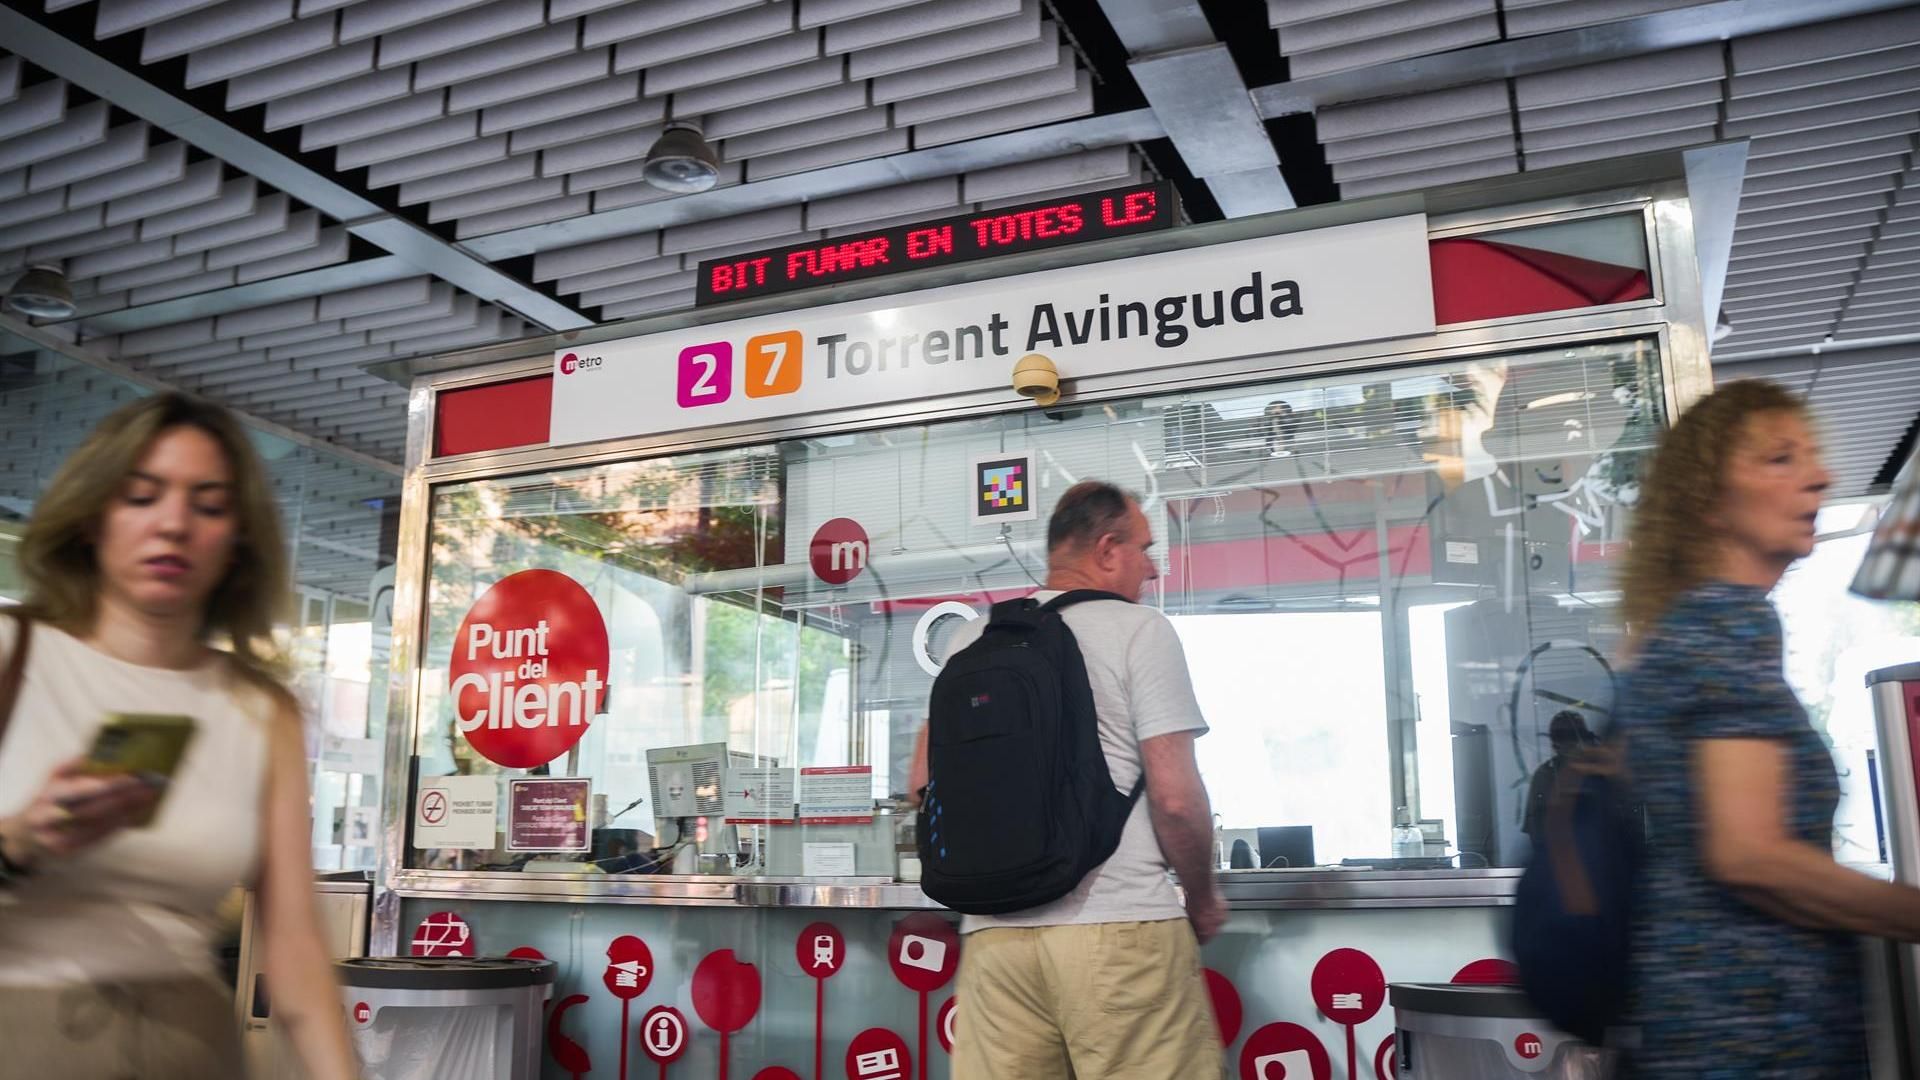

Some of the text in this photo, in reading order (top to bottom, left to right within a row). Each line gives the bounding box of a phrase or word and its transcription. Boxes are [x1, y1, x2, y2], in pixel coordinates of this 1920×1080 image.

[711, 257, 771, 293] BIT
[786, 236, 889, 280] FUMAR
[907, 225, 953, 260] EN
[969, 203, 1084, 248] TOTES
[690, 271, 1304, 397] 2 7 Torrent Avinguda
[831, 540, 866, 571] m
[468, 620, 549, 661] Punt
[518, 658, 549, 680] del
[451, 669, 603, 733] Client
